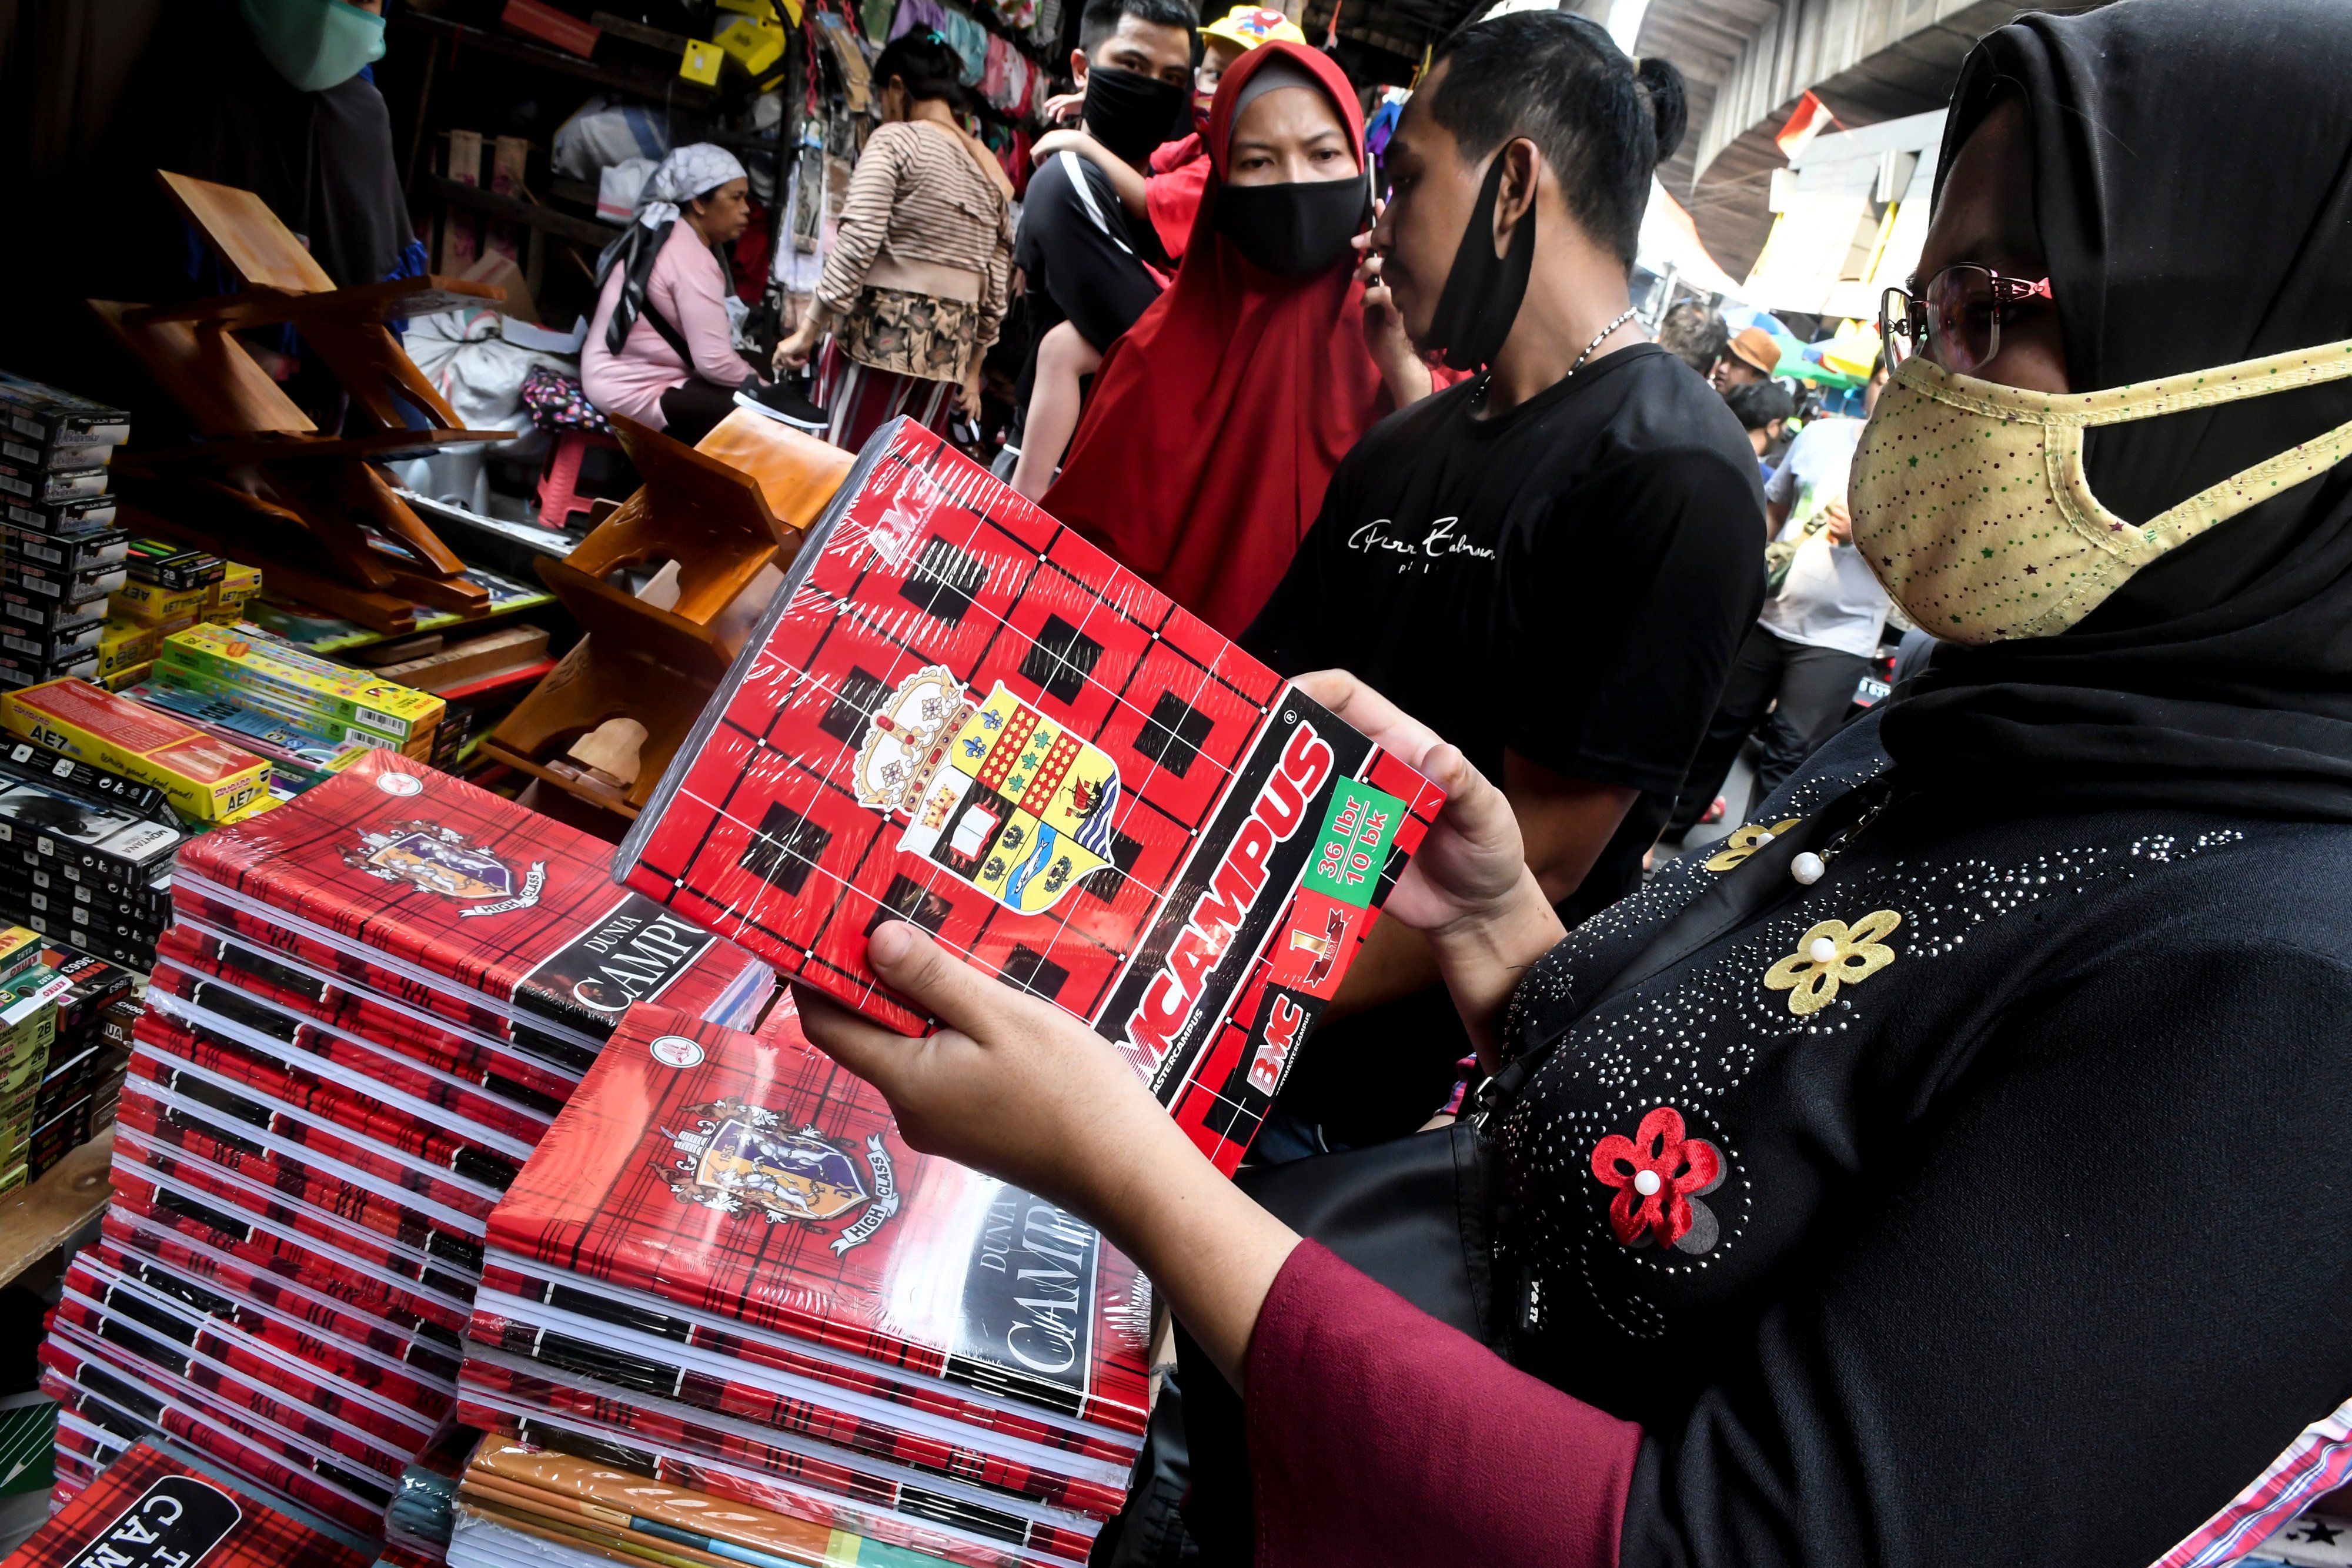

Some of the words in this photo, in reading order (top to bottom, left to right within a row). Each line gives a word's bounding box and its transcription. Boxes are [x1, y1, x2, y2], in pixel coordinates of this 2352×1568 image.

[30, 725, 69, 750] AE7
[227, 788, 254, 813] AE7
[121, 829, 169, 854] MONTANA
[1317, 841, 1345, 878] 36
[1332, 795, 1362, 837] lbr
[1345, 852, 1371, 885] 10
[1359, 809, 1389, 847] bk
[481, 900, 520, 914] HIGH
[522, 874, 540, 898] CLASS
[1115, 720, 1334, 1085] MCAMPUS
[583, 915, 643, 954] DUNIA
[1323, 938, 1336, 960] BEST
[61, 957, 95, 974] 3663
[38, 974, 54, 985] 0192
[115, 1001, 146, 1015] CHOOL
[38, 1021, 51, 1039] 2B
[31, 1048, 45, 1065] 2B
[1247, 993, 1304, 1097] BMC
[15, 1086, 38, 1104] JOYKO
[848, 1208, 883, 1239] HIGH
[870, 1156, 890, 1197] CLASS
[980, 1201, 1017, 1274] DUNIA
[1007, 1195, 1088, 1374] CAMP
